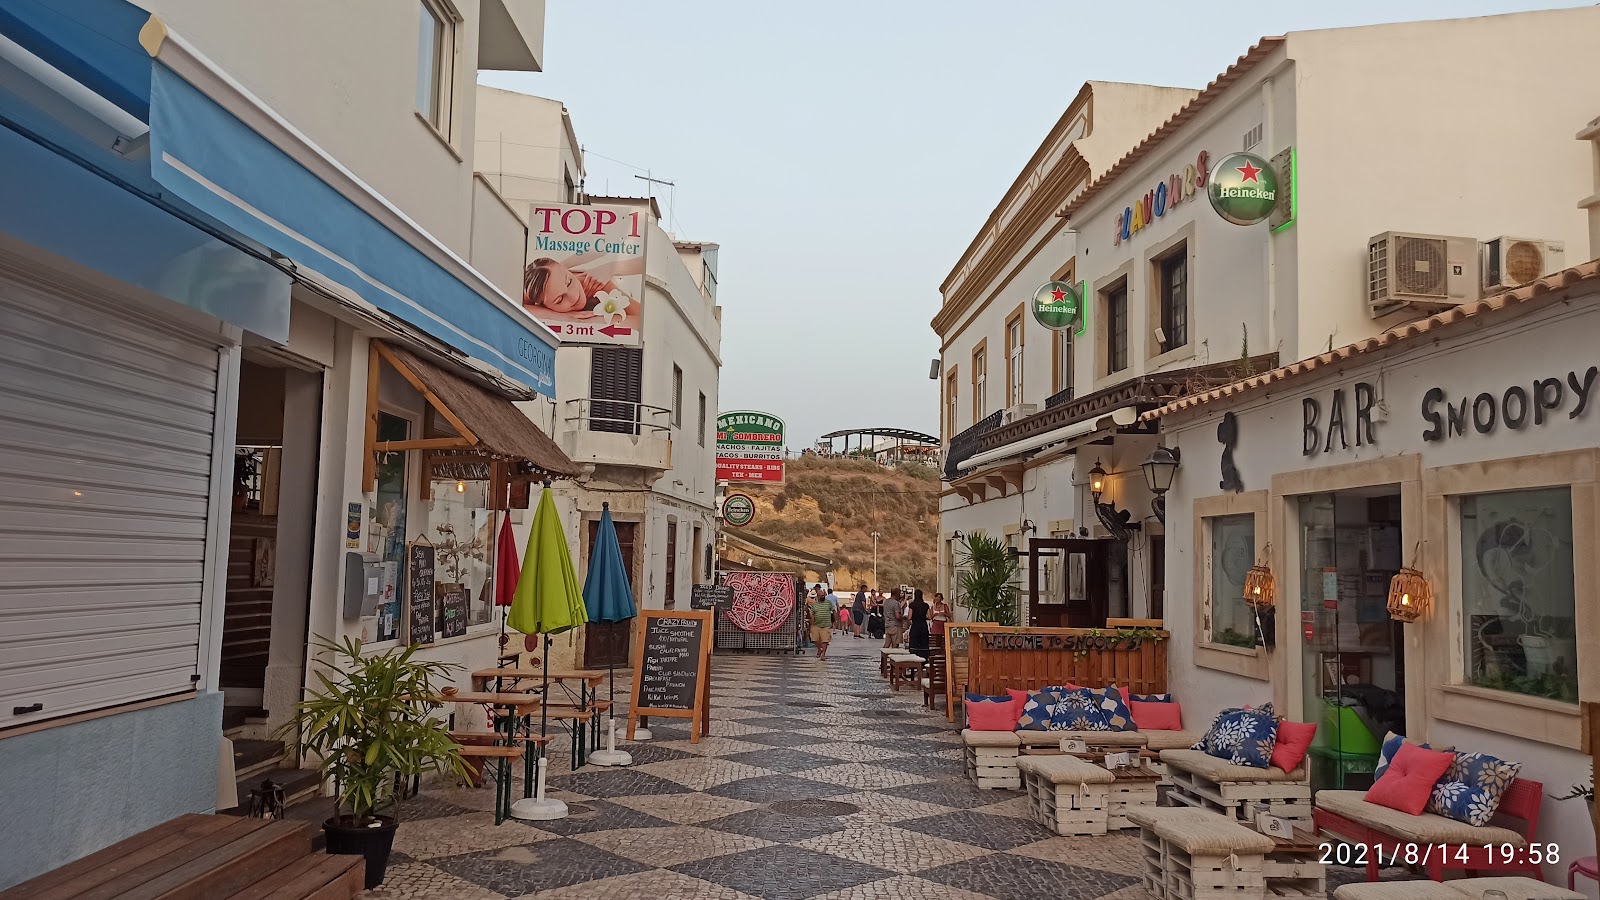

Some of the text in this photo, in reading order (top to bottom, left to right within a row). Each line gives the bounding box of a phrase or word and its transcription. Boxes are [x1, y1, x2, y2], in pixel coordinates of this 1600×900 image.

[1113, 150, 1210, 246] FLAVOURS
[1220, 187, 1276, 201] Heineken
[534, 207, 640, 237] TOP 1
[535, 236, 640, 255] Massage Center
[1038, 304, 1077, 315] Heineken
[518, 337, 552, 374] GEORGINA
[717, 414, 781, 431] MEXICANO
[1302, 382, 1377, 457] BAR
[733, 432, 781, 442] SOMBRERO
[657, 618, 680, 627] CRAZY
[984, 635, 1043, 649] WELCOME
